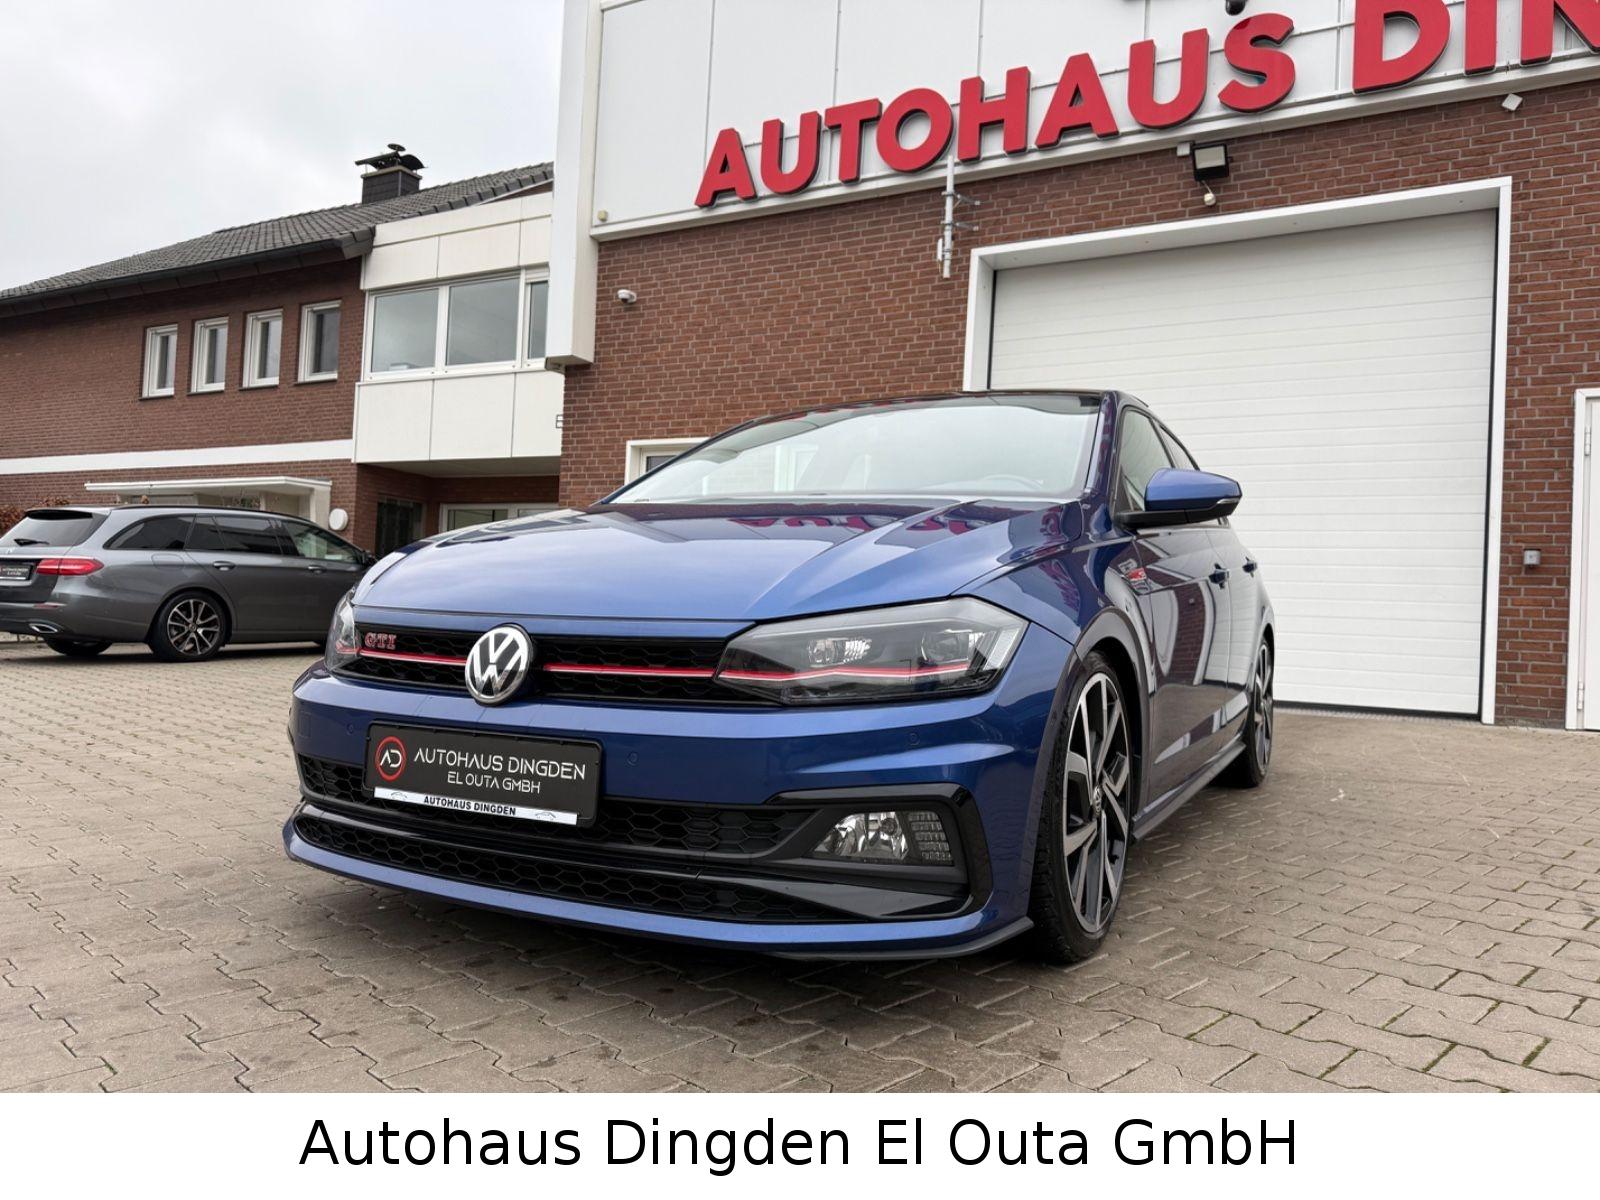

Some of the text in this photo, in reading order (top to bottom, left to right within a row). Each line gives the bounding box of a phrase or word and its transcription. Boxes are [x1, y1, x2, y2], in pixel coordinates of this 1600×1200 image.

[694, 12, 1295, 208] AUTOHAUS
[364, 631, 397, 650] GTI
[413, 748, 586, 780] AUTOHAUS DINGDEN
[447, 771, 541, 794] EL OUTA GMBH
[423, 795, 517, 816] AUTOHAUS DINGDEN
